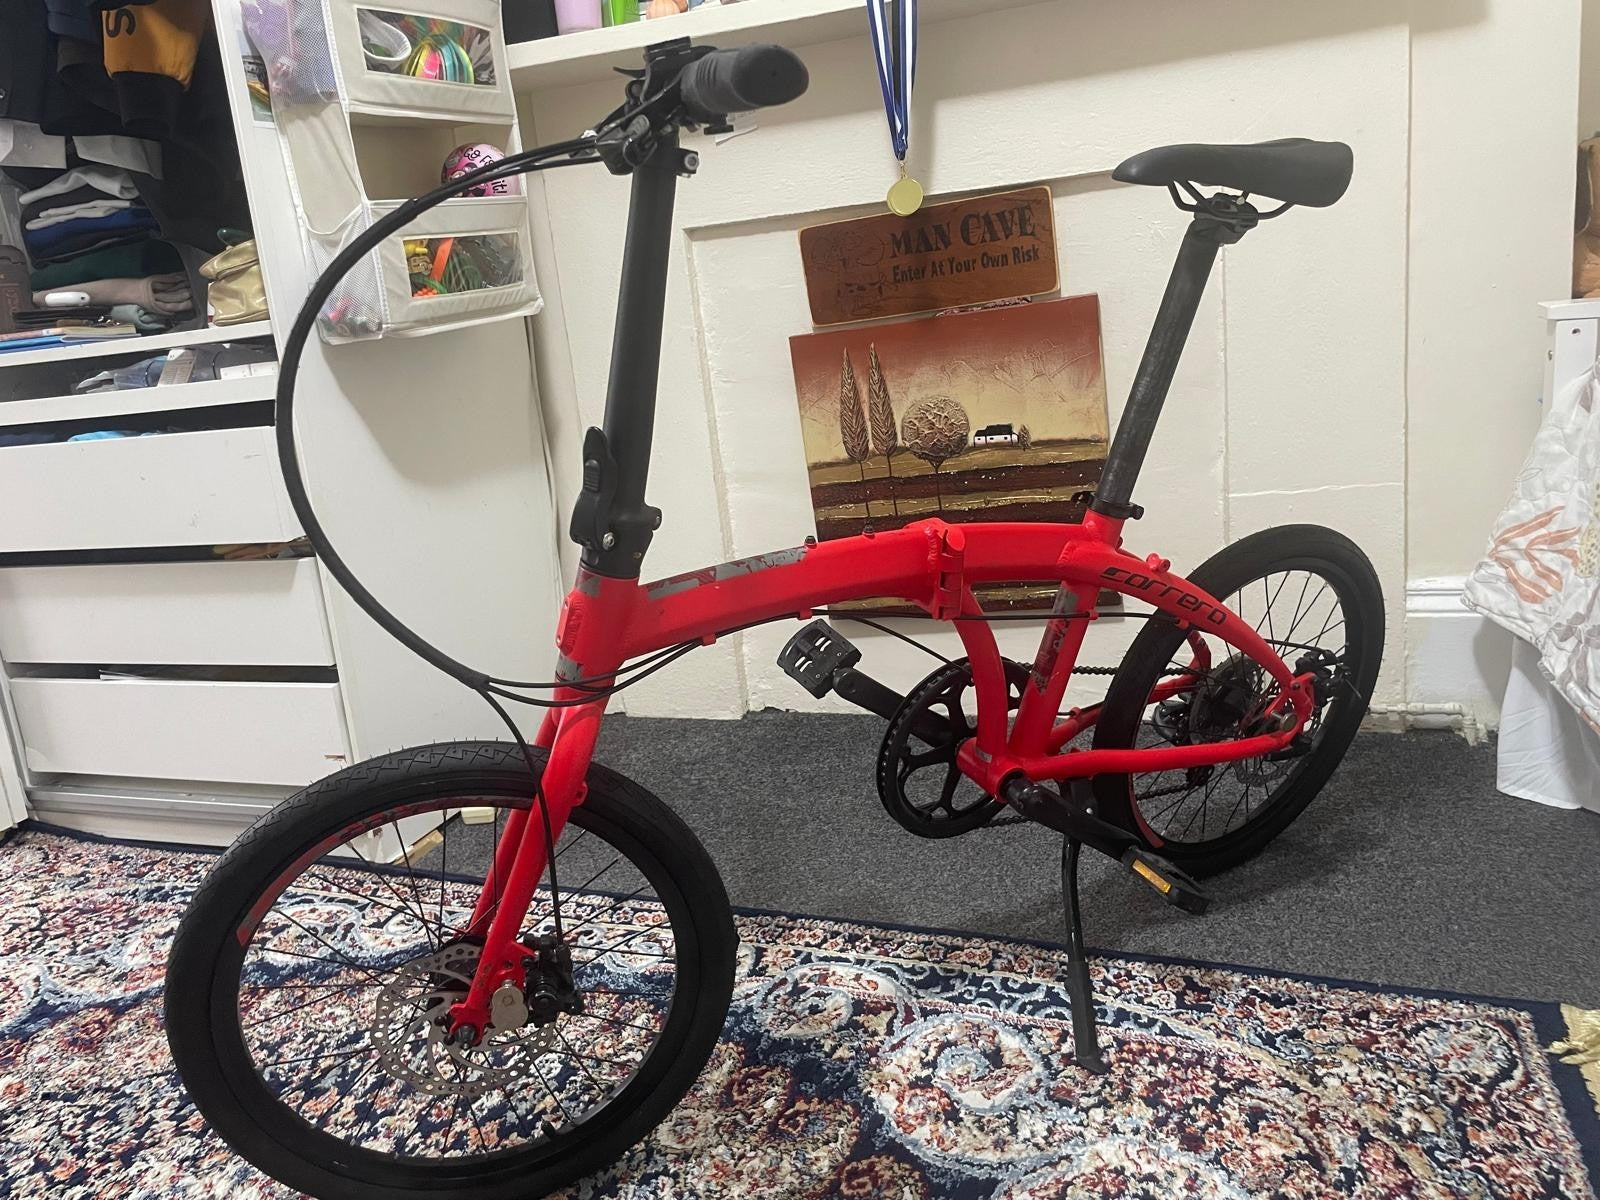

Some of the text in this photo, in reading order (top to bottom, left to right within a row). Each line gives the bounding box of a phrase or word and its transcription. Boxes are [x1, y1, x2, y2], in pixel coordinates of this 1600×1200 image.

[491, 179, 508, 194] it!
[890, 203, 1037, 258] MAN CAVE
[892, 244, 1040, 284] Enter At Your Own Risk
